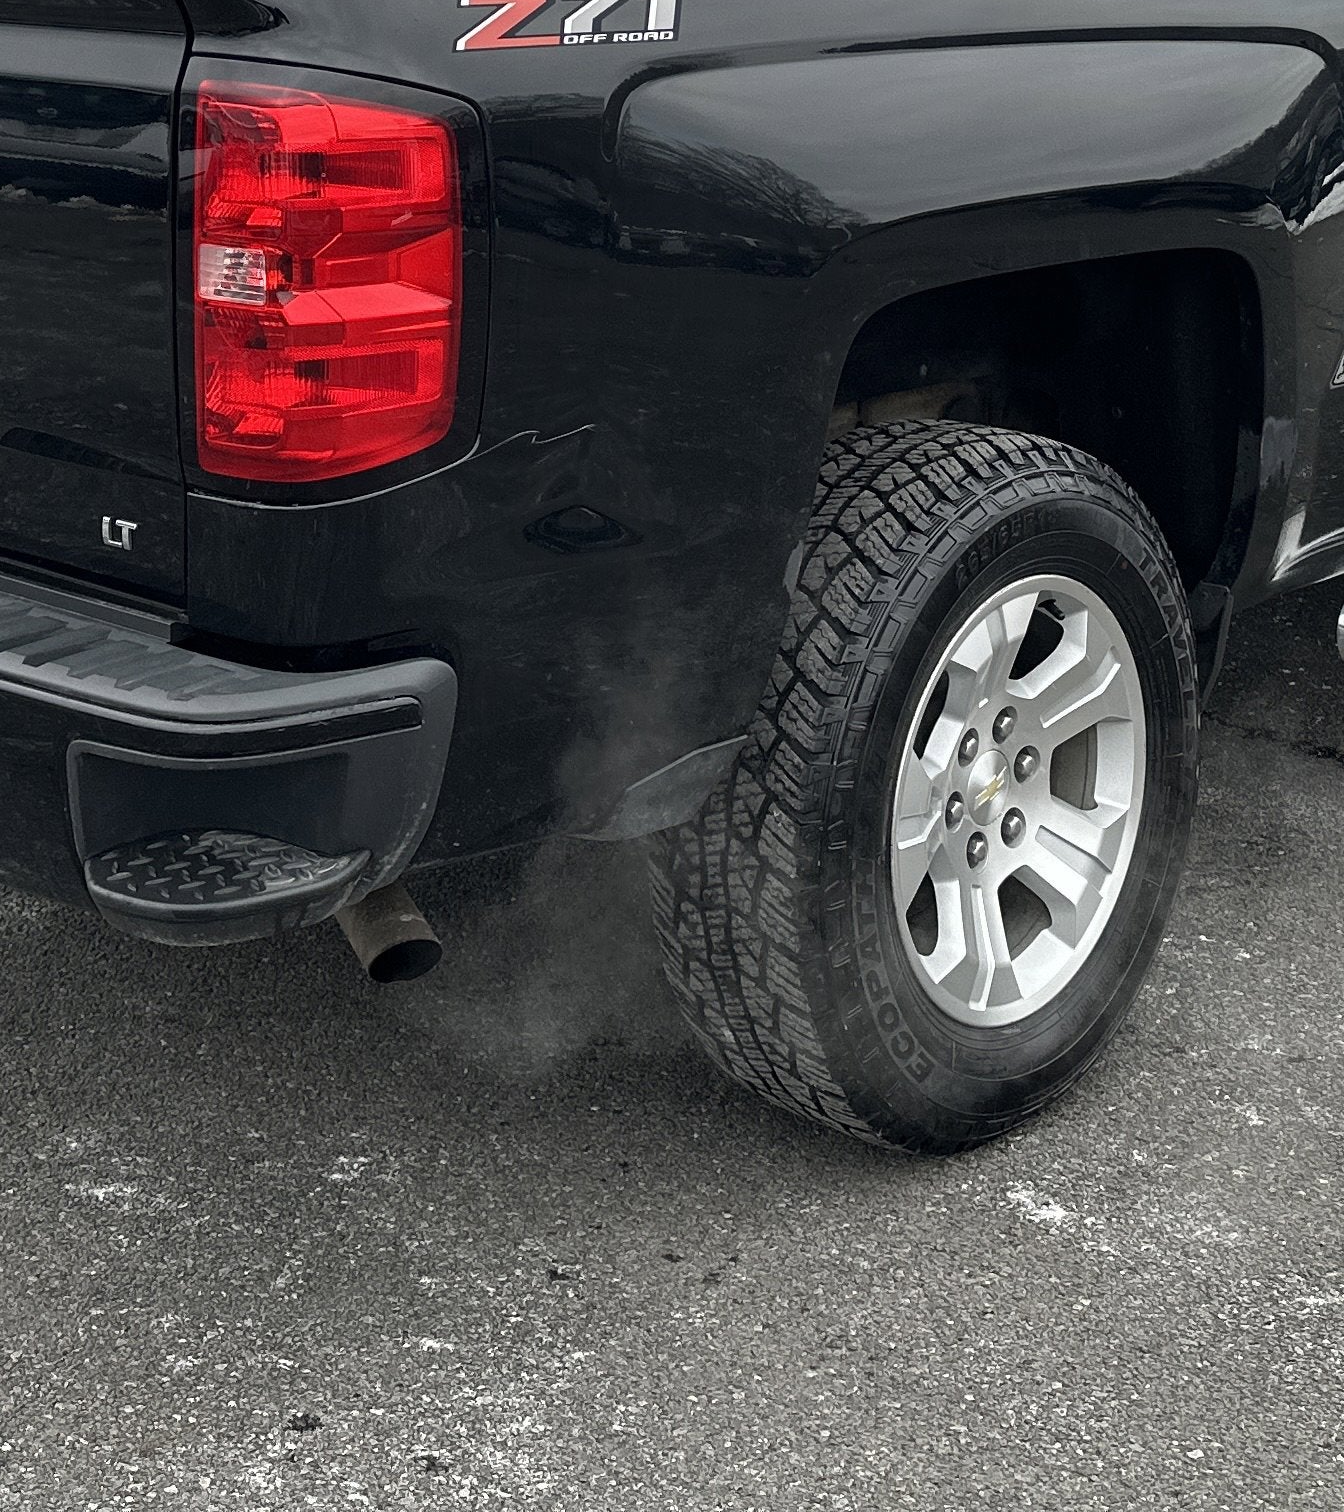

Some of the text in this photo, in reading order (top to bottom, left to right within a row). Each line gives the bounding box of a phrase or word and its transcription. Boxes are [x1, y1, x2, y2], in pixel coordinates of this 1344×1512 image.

[563, 31, 674, 45] OFF ROAD
[102, 516, 137, 551] LT
